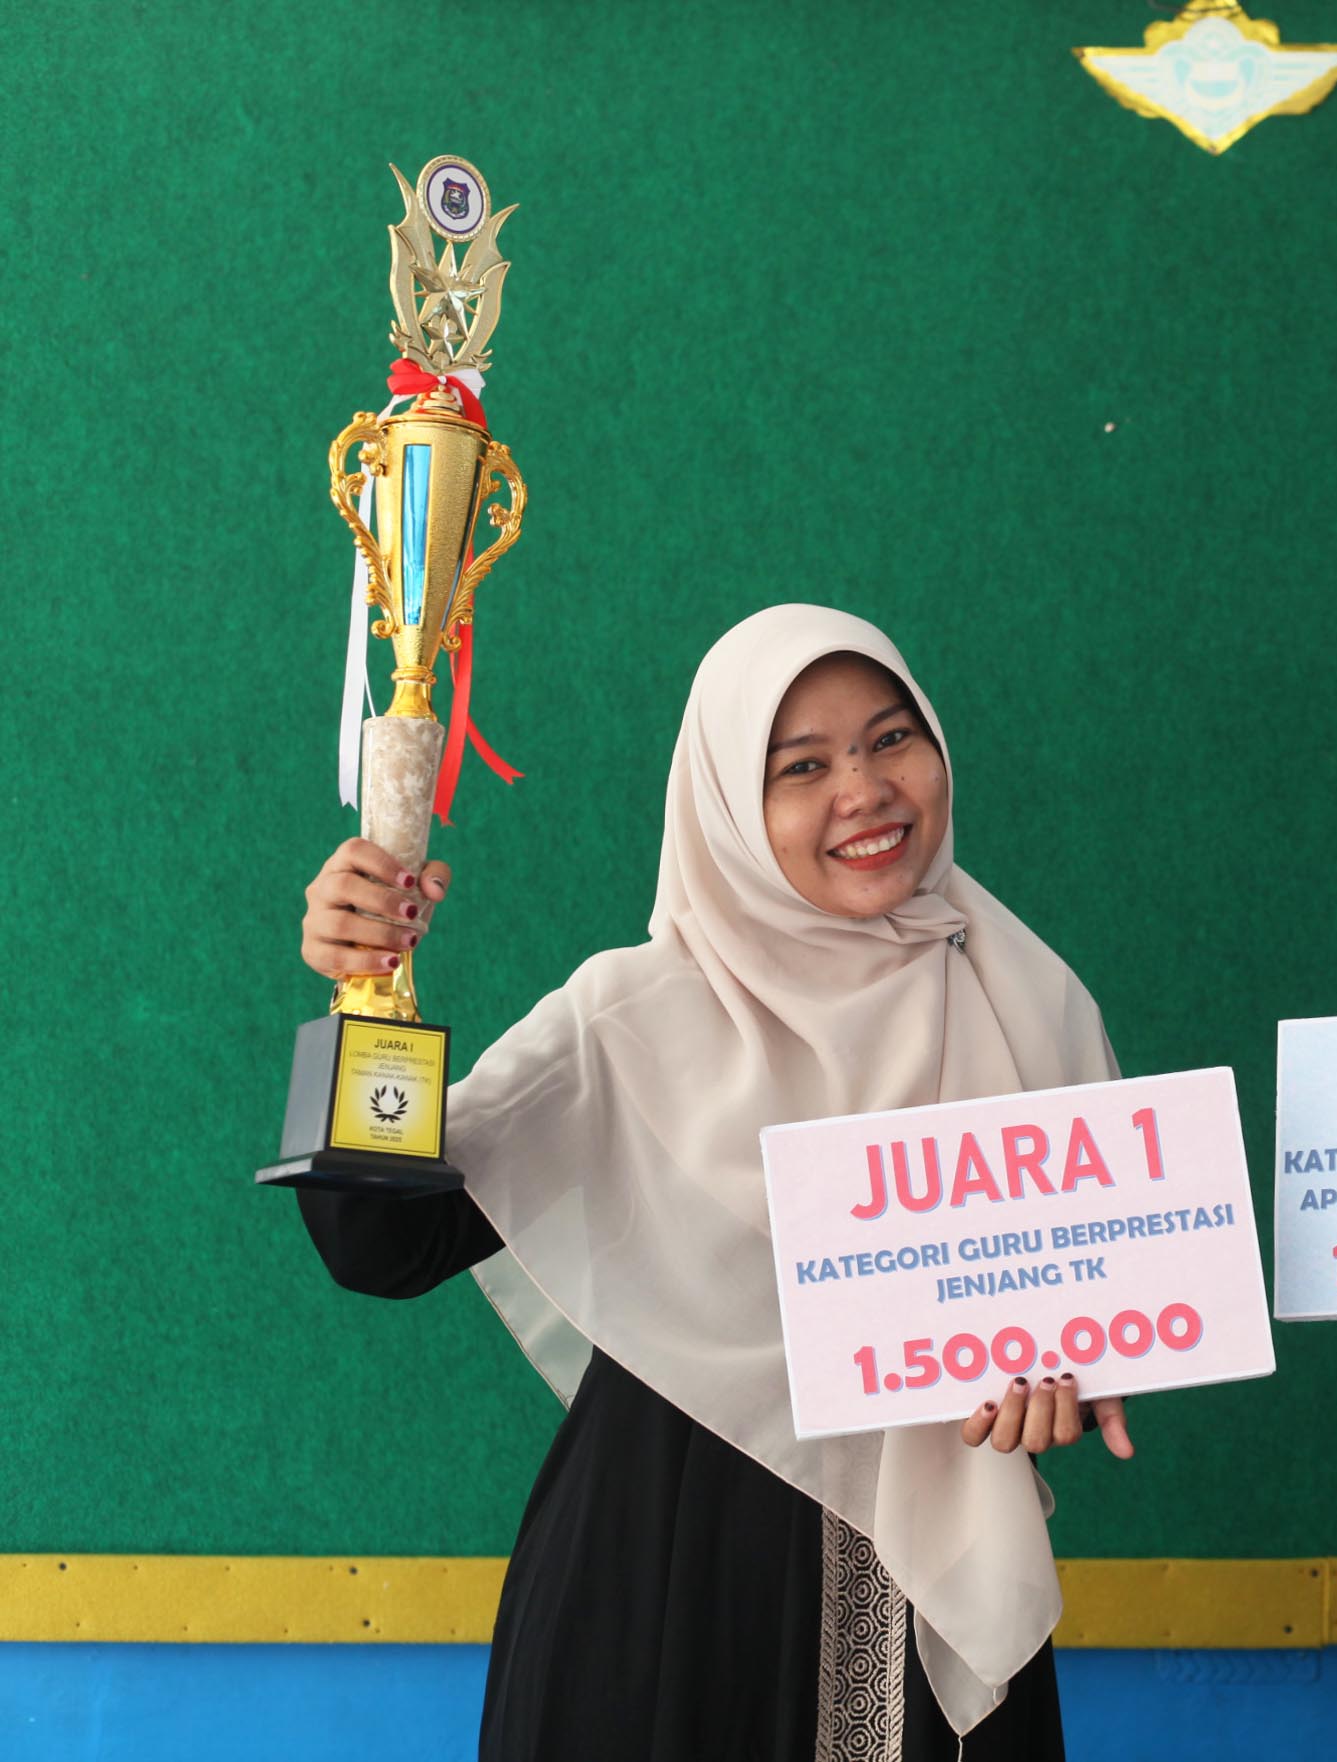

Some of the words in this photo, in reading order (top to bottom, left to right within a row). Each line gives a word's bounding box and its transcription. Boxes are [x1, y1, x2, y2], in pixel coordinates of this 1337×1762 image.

[374, 1039, 408, 1051] JUARA
[850, 1116, 1116, 1221] JUARA
[1131, 1107, 1166, 1181] 1
[796, 1242, 950, 1286] KATEGORI
[958, 1229, 1043, 1262] GURU
[1052, 1204, 1236, 1246] BERPRESTASI
[936, 1264, 1062, 1303] JENJANG
[1075, 1257, 1107, 1280] TK
[853, 1302, 1204, 1395] 1.500.000
